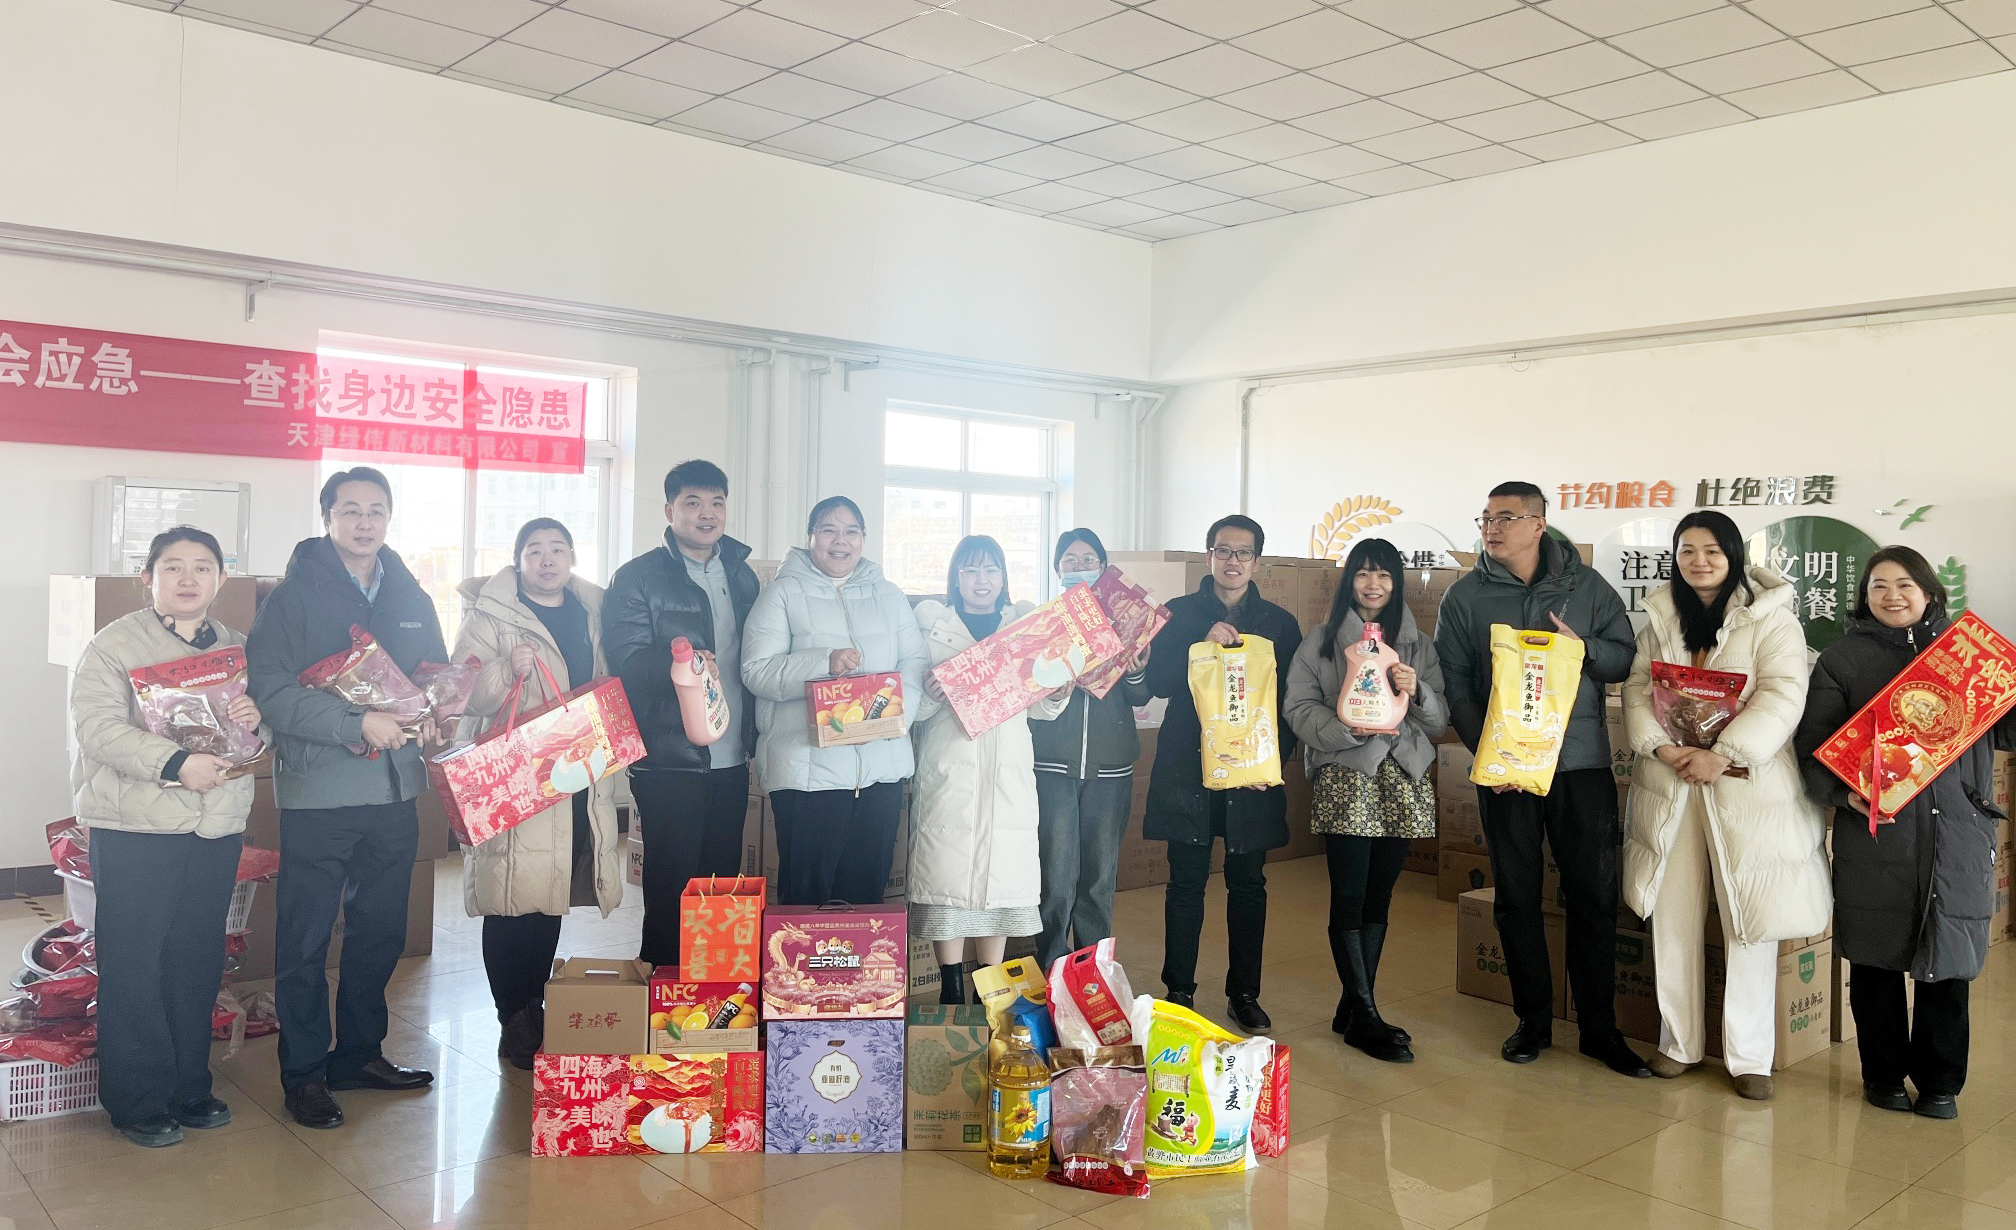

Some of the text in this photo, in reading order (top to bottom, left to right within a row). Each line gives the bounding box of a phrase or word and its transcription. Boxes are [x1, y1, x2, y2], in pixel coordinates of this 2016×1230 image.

[1557, 475, 1836, 510] 节约粮食 杜绝浪费
[1399, 550, 1436, 568] 惜
[1620, 550, 1673, 580] 注意
[1767, 547, 1839, 585] 文明
[1845, 555, 1856, 611] 中华饮食美德
[1791, 587, 1839, 621] 餐
[950, 643, 988, 675] 四海
[961, 659, 996, 687] 九州
[822, 683, 852, 701] NFC
[1227, 673, 1239, 722] 金龙鱼御品
[1523, 671, 1535, 723] 金龙鱼御品
[474, 758, 512, 786] 九州
[808, 955, 861, 968] 三只松鼠
[1475, 942, 1506, 960] 金龙
[662, 983, 698, 1001] NFC
[723, 1002, 739, 1015] NFC
[568, 1012, 622, 1029] 柴鸡蛋
[559, 1056, 604, 1079] 四海
[559, 1077, 603, 1100] 九州
[551, 1105, 614, 1128] 之美味
[913, 1109, 960, 1121] 茉莉花茶
[1161, 1098, 1186, 1127] 福
[592, 1126, 614, 1149] 也
